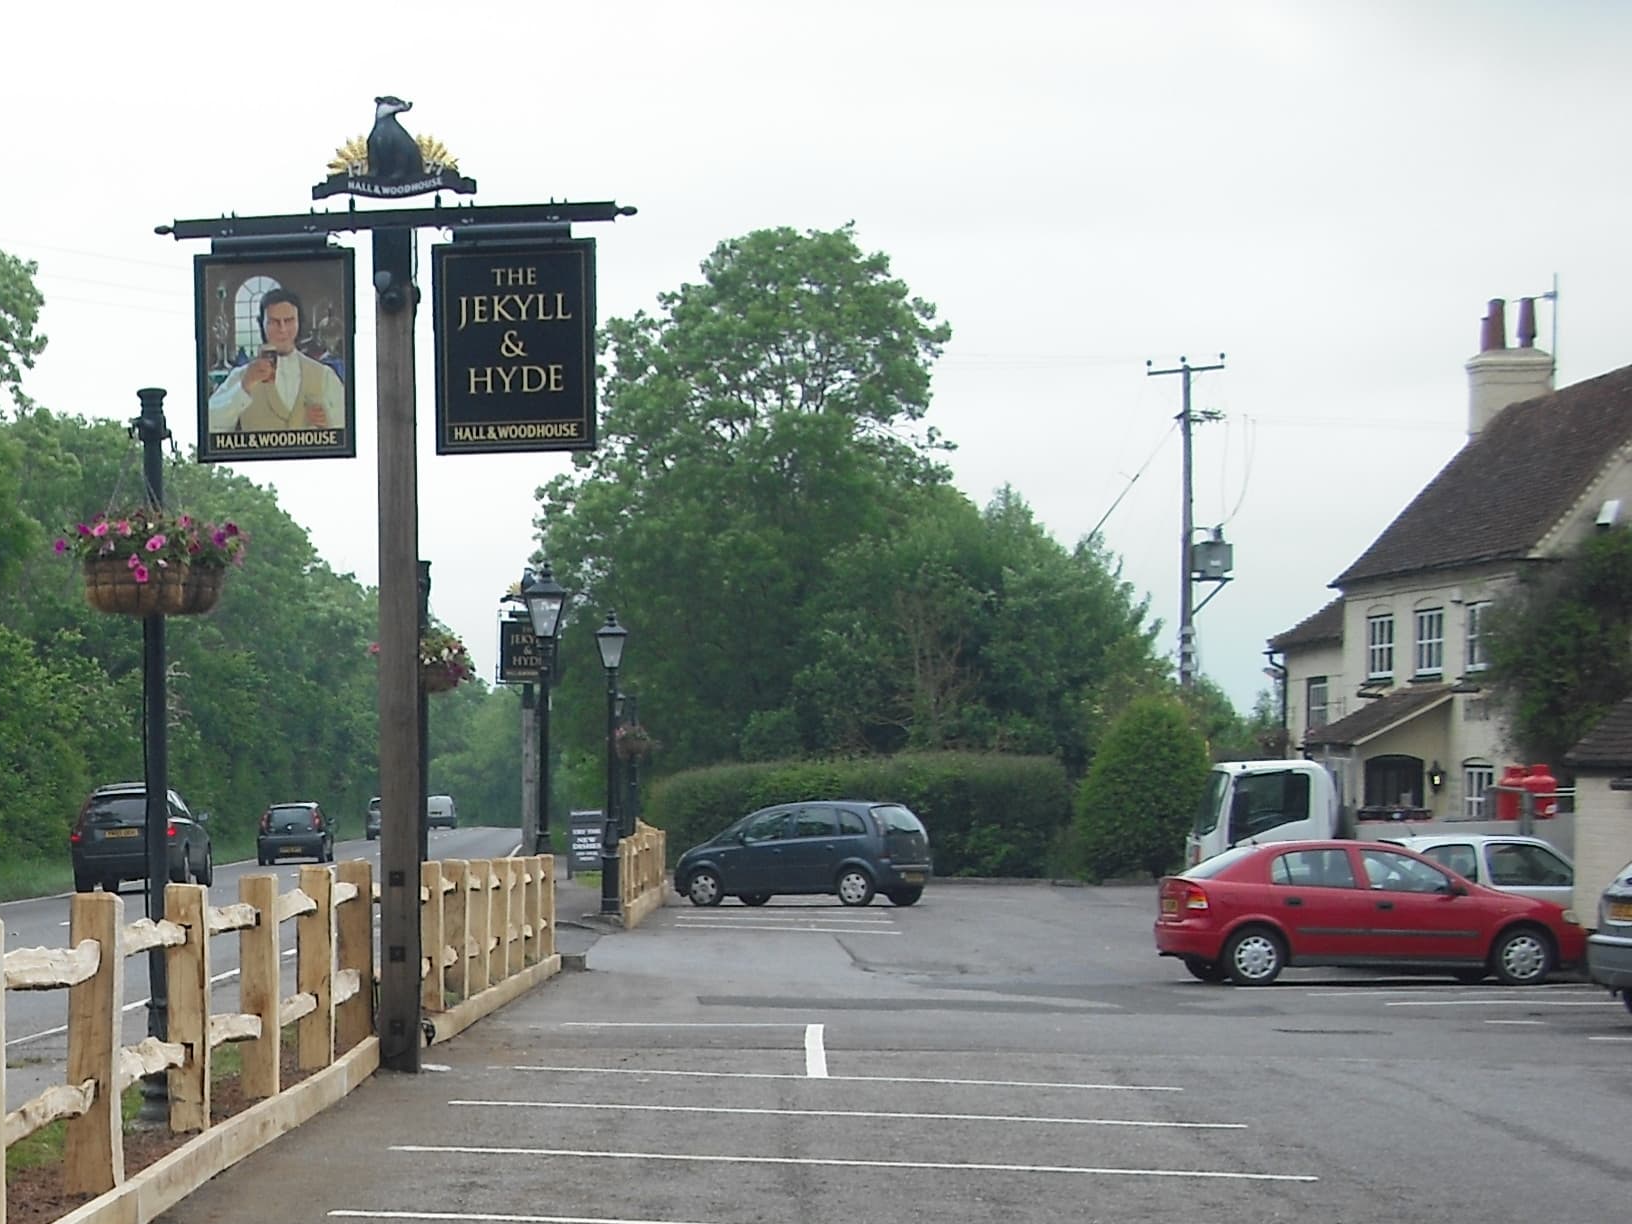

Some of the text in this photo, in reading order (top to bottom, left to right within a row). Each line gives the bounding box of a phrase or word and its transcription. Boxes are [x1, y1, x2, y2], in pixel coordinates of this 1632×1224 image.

[491, 267, 537, 287] THE
[457, 292, 572, 331] JEKYLL
[500, 330, 528, 358] &
[468, 364, 564, 395] HYDE
